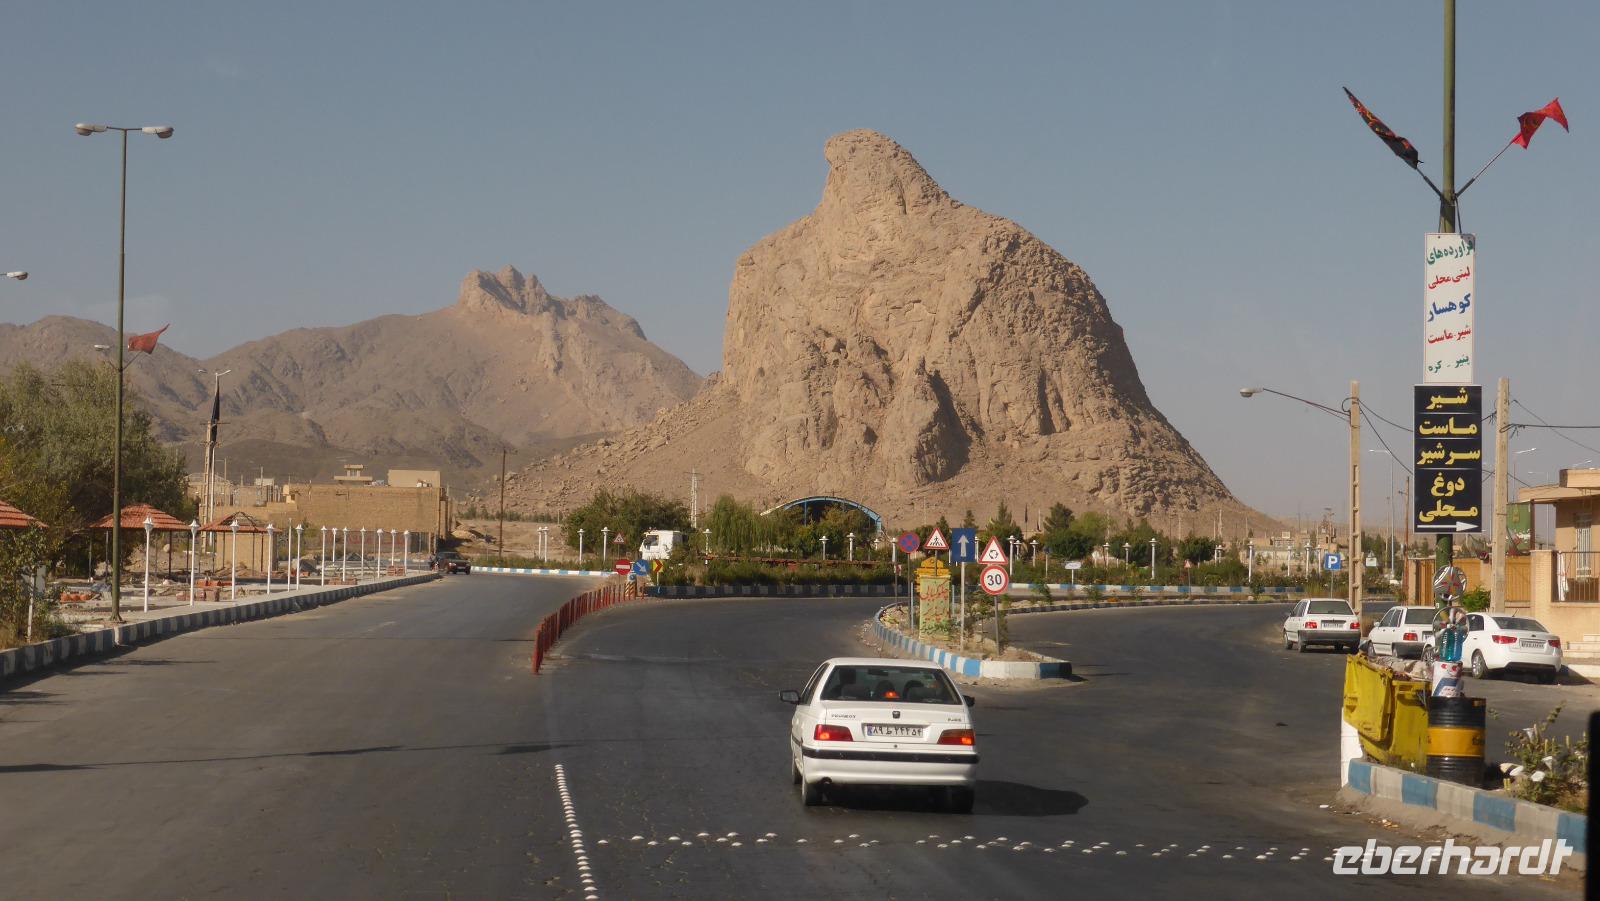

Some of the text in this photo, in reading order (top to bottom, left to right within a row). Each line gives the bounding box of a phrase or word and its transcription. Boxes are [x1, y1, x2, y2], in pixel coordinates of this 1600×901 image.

[1452, 266, 1471, 283] لبنی
[1428, 360, 1442, 374] کره
[1454, 354, 1470, 369] پنیر
[1426, 387, 1468, 409] شیر
[1419, 416, 1478, 435] ماست
[1430, 472, 1465, 497] دوغ
[1419, 499, 1479, 523] محلی
[1327, 555, 1338, 569] P
[986, 574, 1002, 586] 30
